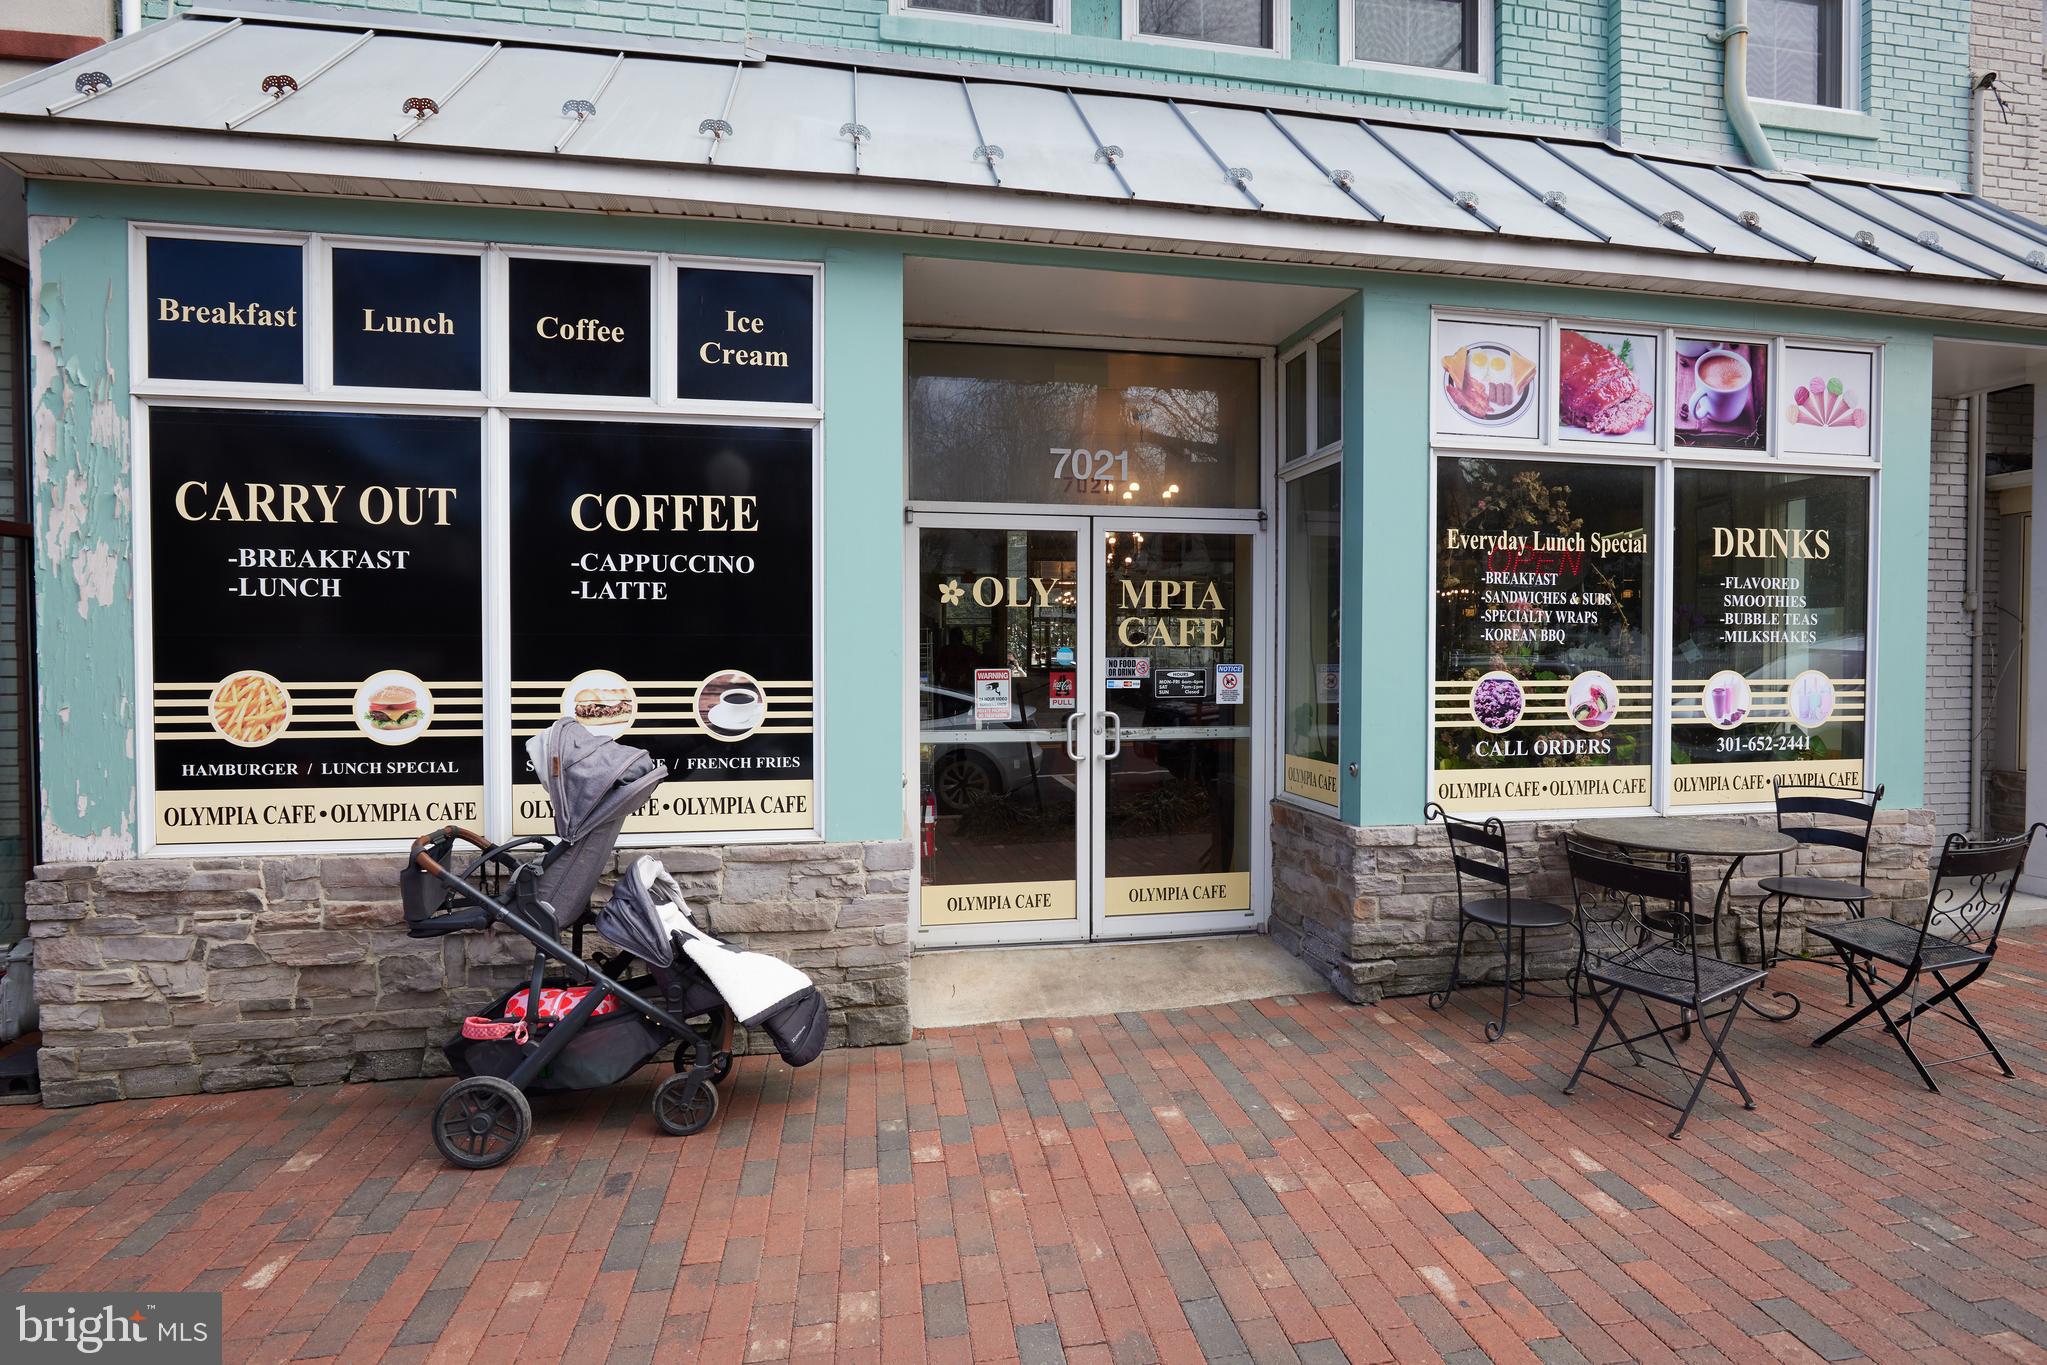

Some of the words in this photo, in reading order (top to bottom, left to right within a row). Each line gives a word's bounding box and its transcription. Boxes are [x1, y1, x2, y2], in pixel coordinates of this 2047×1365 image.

[157, 297, 297, 327] Breakfast
[362, 308, 455, 335] Lunch
[725, 310, 764, 334] Ice
[536, 316, 625, 343] Coffee
[699, 341, 789, 368] Cream
[1050, 447, 1128, 481] 7021
[175, 480, 346, 523] CARRY
[359, 485, 457, 526] OUT
[571, 493, 759, 532] COFFEE
[1447, 528, 1529, 557] Everyday
[1533, 530, 1585, 552] Lunch
[1590, 531, 1647, 559] Special
[1712, 526, 1830, 560] DRINKS
[228, 547, 410, 570] -BREAKFAST
[571, 552, 755, 574] -CAPPUCCINO
[228, 577, 342, 598] -LUNCH
[1481, 571, 1558, 586] -BREAKFAST
[1720, 576, 1800, 590] -FLAVORED
[571, 580, 668, 600] -LATTE
[972, 576, 1060, 608] OLY
[1118, 578, 1226, 611] MPIA
[1481, 590, 1567, 605] -SANDWICHES
[1569, 591, 1580, 605] &
[1582, 592, 1612, 606] SUBS
[1723, 594, 1807, 608] SMOOTHIES
[1480, 609, 1553, 624] -SPECIALTY
[1555, 610, 1598, 625] WRAPS
[1719, 612, 1780, 626] -BUBBLE
[1782, 613, 1818, 626] TEAS
[1117, 616, 1226, 648] CAFE
[1480, 628, 1537, 642] -KOREAN
[1540, 629, 1565, 645] BBQ
[1719, 630, 1817, 643] -MILKSHAKES
[1108, 660, 1118, 668] NO
[1119, 660, 1136, 668] FOOD
[1108, 668, 1116, 677] OR
[1117, 668, 1136, 677] DRINK
[1475, 740, 1529, 757] CALL
[1533, 738, 1611, 756] ORDERS
[1716, 735, 1811, 753] 301-652-2441
[181, 762, 299, 777] HAMBURGER
[307, 762, 313, 775] /
[321, 761, 382, 775] LUNCH
[386, 761, 459, 774] SPECIAL
[687, 757, 751, 770] FRENCH
[756, 756, 801, 769] FRIES
[1288, 766, 1317, 788] OLYMPIA
[1318, 773, 1337, 793] CAFE
[1439, 782, 1504, 800] OLYMPIA
[1505, 781, 1540, 797] CAFE
[1550, 779, 1609, 796] OLYMPIA
[1612, 778, 1646, 795] CAFE
[1674, 776, 1729, 793] OLYMPIA
[1732, 774, 1764, 791] CAFE
[1829, 771, 1859, 787] CAFE
[164, 805, 258, 827] OLYMPIA
[263, 804, 316, 825] CAFE
[331, 802, 420, 824] OLYMPIA
[426, 801, 477, 822] CAFE
[673, 795, 756, 816] OLYMPIA
[760, 795, 807, 814] CAFE
[947, 895, 1012, 912] OLYMPIA
[1015, 893, 1051, 909] CAFE
[1128, 886, 1189, 903] OLYMPIA
[1192, 884, 1227, 900] CAFE
